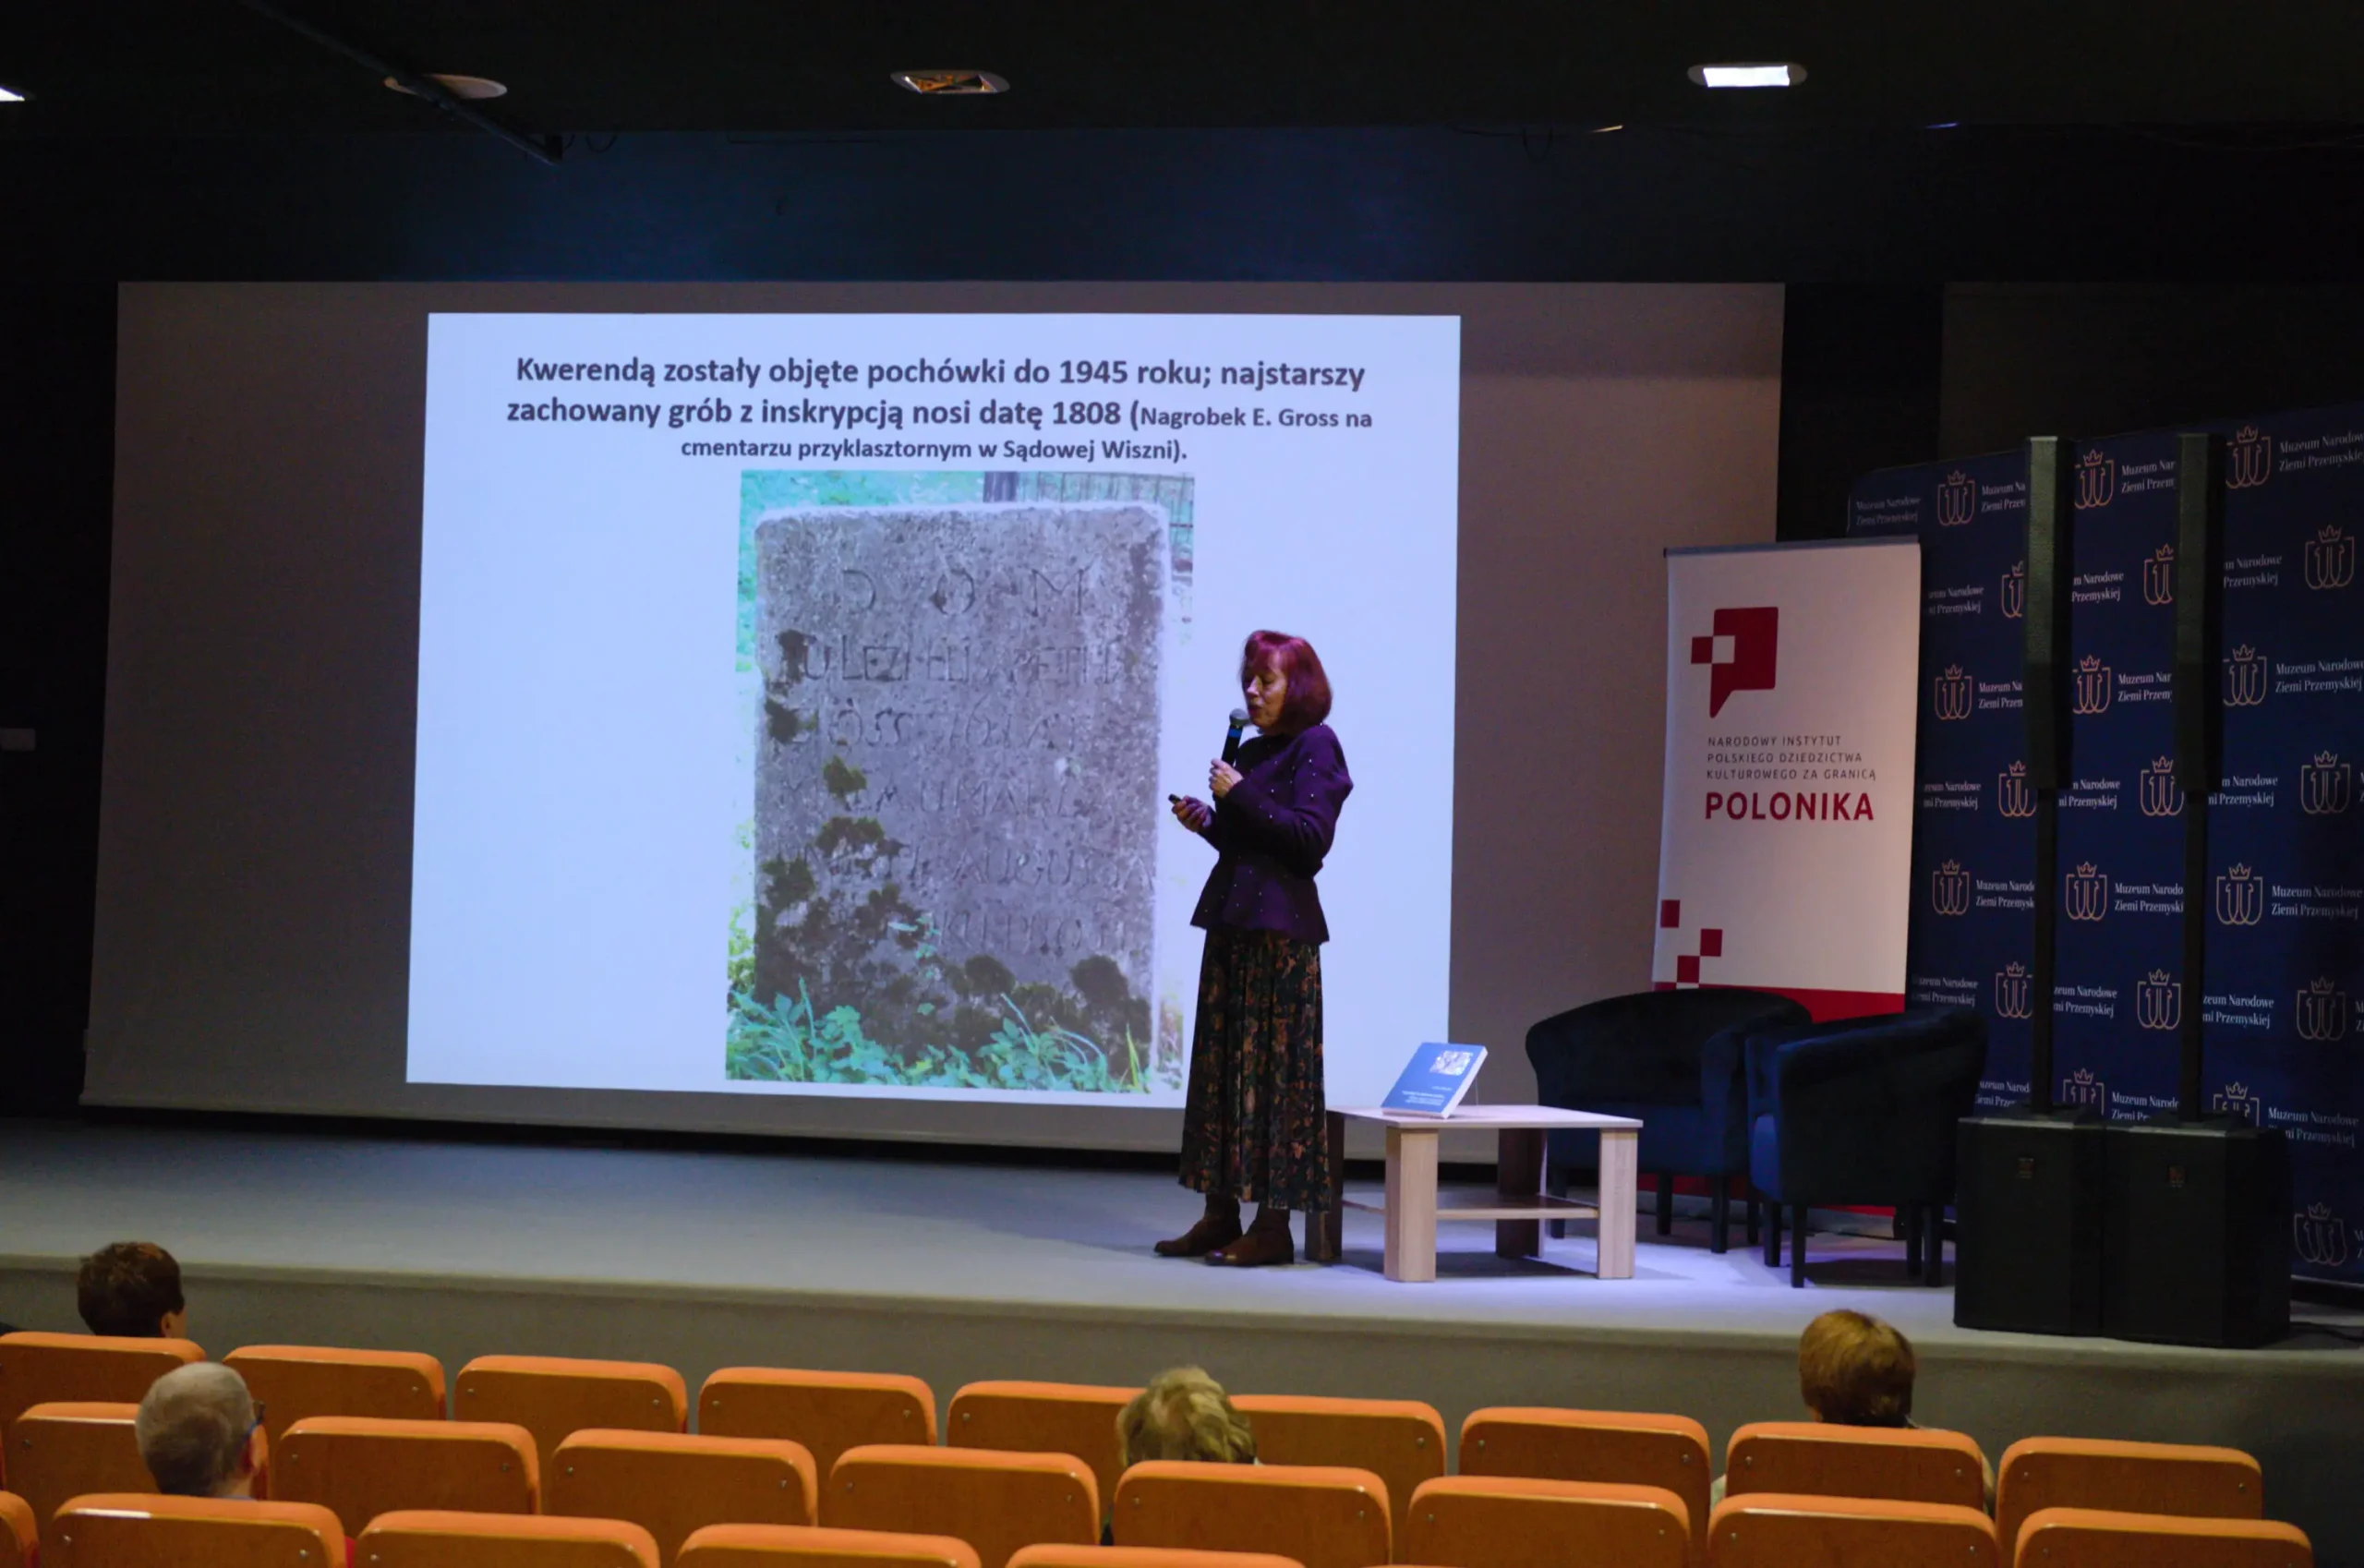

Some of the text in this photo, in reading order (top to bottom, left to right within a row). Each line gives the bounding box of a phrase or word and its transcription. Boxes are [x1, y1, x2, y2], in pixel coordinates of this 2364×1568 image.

[516, 356, 1365, 392] Kwerendą zostały objęte pochówki do 1945 roku; najstarszy
[507, 396, 1371, 431] zachowany grób z inskrypcją nosi datę 1808 (Nagrobek E. Gross na
[2279, 430, 2364, 453] Muzeum Narodow
[681, 439, 1188, 462] cmentarzu przyklasztornym w Sądowej Wiszni).
[2121, 462, 2157, 476] Muzeum
[2279, 459, 2306, 472] Ziemi
[1982, 484, 2014, 496] Muzeum
[2121, 481, 2145, 494] Ziemi
[1981, 501, 2003, 513] Ziemi
[2236, 553, 2283, 570] Narodowe
[2083, 569, 2124, 586] Narodowe
[2223, 572, 2279, 589] Przemyskiej
[1948, 584, 1984, 597] Narodowe
[2071, 585, 2121, 604] Przemyskiej
[1936, 601, 1982, 616] Przemyskiej
[2276, 662, 2316, 675] Muzeum
[2117, 672, 2154, 685] Muzeum
[2275, 676, 2363, 694] Ziemi Przemyskiej
[1979, 681, 2010, 693] Muzeum
[1978, 697, 2001, 709] Ziemi
[2117, 690, 2141, 703] Ziemi
[1708, 735, 1841, 747] NARODOWY INSTYTUT
[1707, 752, 1862, 764] POLSKIEGO DZIEDZICTWA
[1707, 768, 1876, 781] KULTUROWEGO ZA GRANICĄ
[2234, 774, 2278, 788] Narodowe
[1945, 779, 1982, 791] Narodowe
[2080, 778, 2121, 790] Narodowe
[1705, 791, 1875, 820] POLONIKA
[1935, 795, 1978, 811] Przemyskiej
[2068, 794, 2117, 810] Przemyskiej
[2219, 790, 2274, 808] Przemyskiej
[1976, 879, 2008, 892] Muzeum
[2115, 883, 2184, 896] Muzeum Narodo
[2272, 885, 2363, 899] Muzeum Narodowe
[1975, 896, 2035, 911] Ziemi Przemysk
[2115, 899, 2184, 916] Ziemi Przemyski
[2271, 902, 2359, 922] Ziemi Przemyskiej
[1942, 976, 1979, 989] Narodowe
[1932, 992, 1976, 1007] Przemyskiej
[2054, 985, 2117, 1000] zeum Narodowe
[2202, 994, 2274, 1009] zeum Narodowe
[2065, 1002, 2115, 1019] Przemyskiej
[2215, 1013, 2271, 1030] Przemyskiej
[1979, 1080, 2031, 1094] uzeum Narod
[2112, 1091, 2148, 1106] Muzeum
[2111, 1108, 2138, 1121] Ziemi
[2267, 1106, 2359, 1128] Muzeum Narodowe
[2295, 1128, 2356, 1149] Przemyskiej
